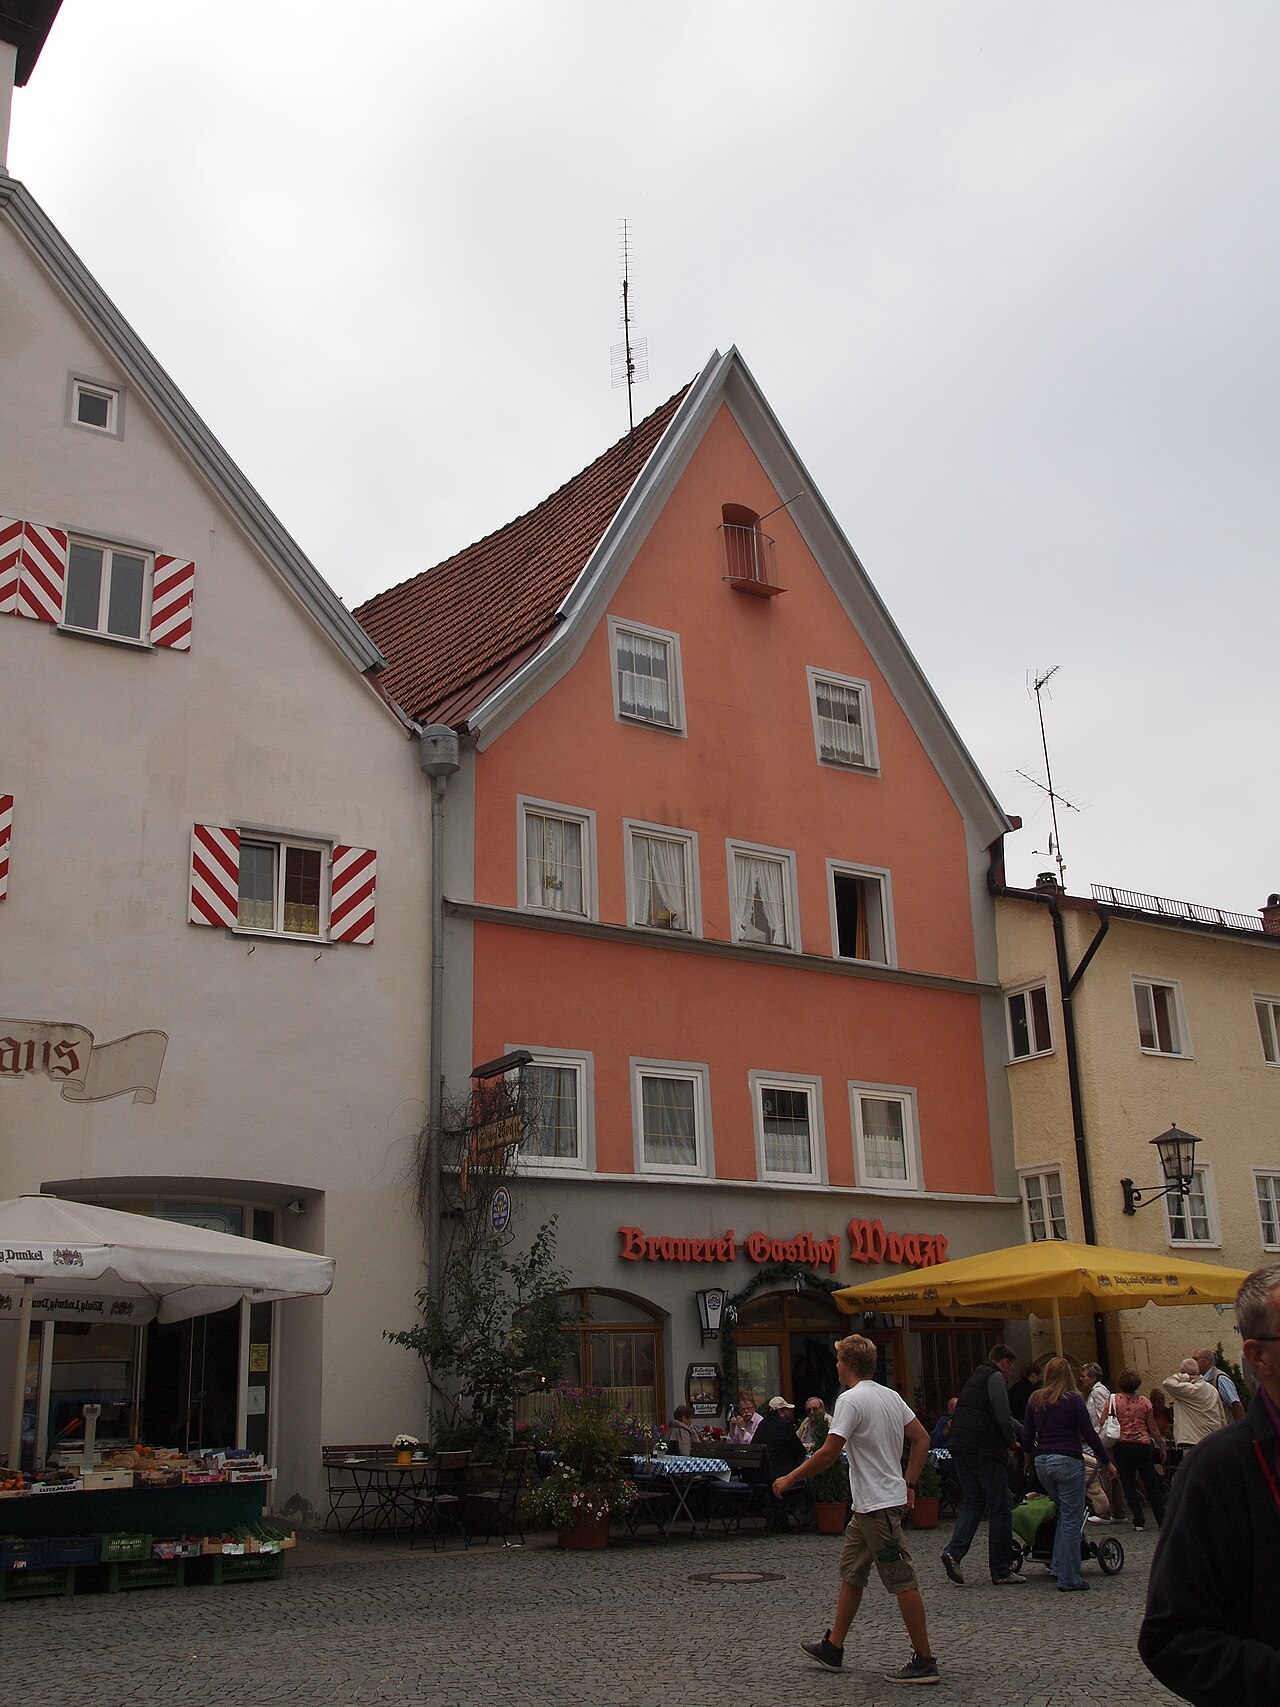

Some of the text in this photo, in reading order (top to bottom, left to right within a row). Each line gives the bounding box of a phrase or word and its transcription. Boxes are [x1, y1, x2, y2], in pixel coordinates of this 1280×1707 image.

[5, 1249, 44, 1263] Dunkel
[617, 1218, 949, 1274] Brauerei Gasthof Woaze
